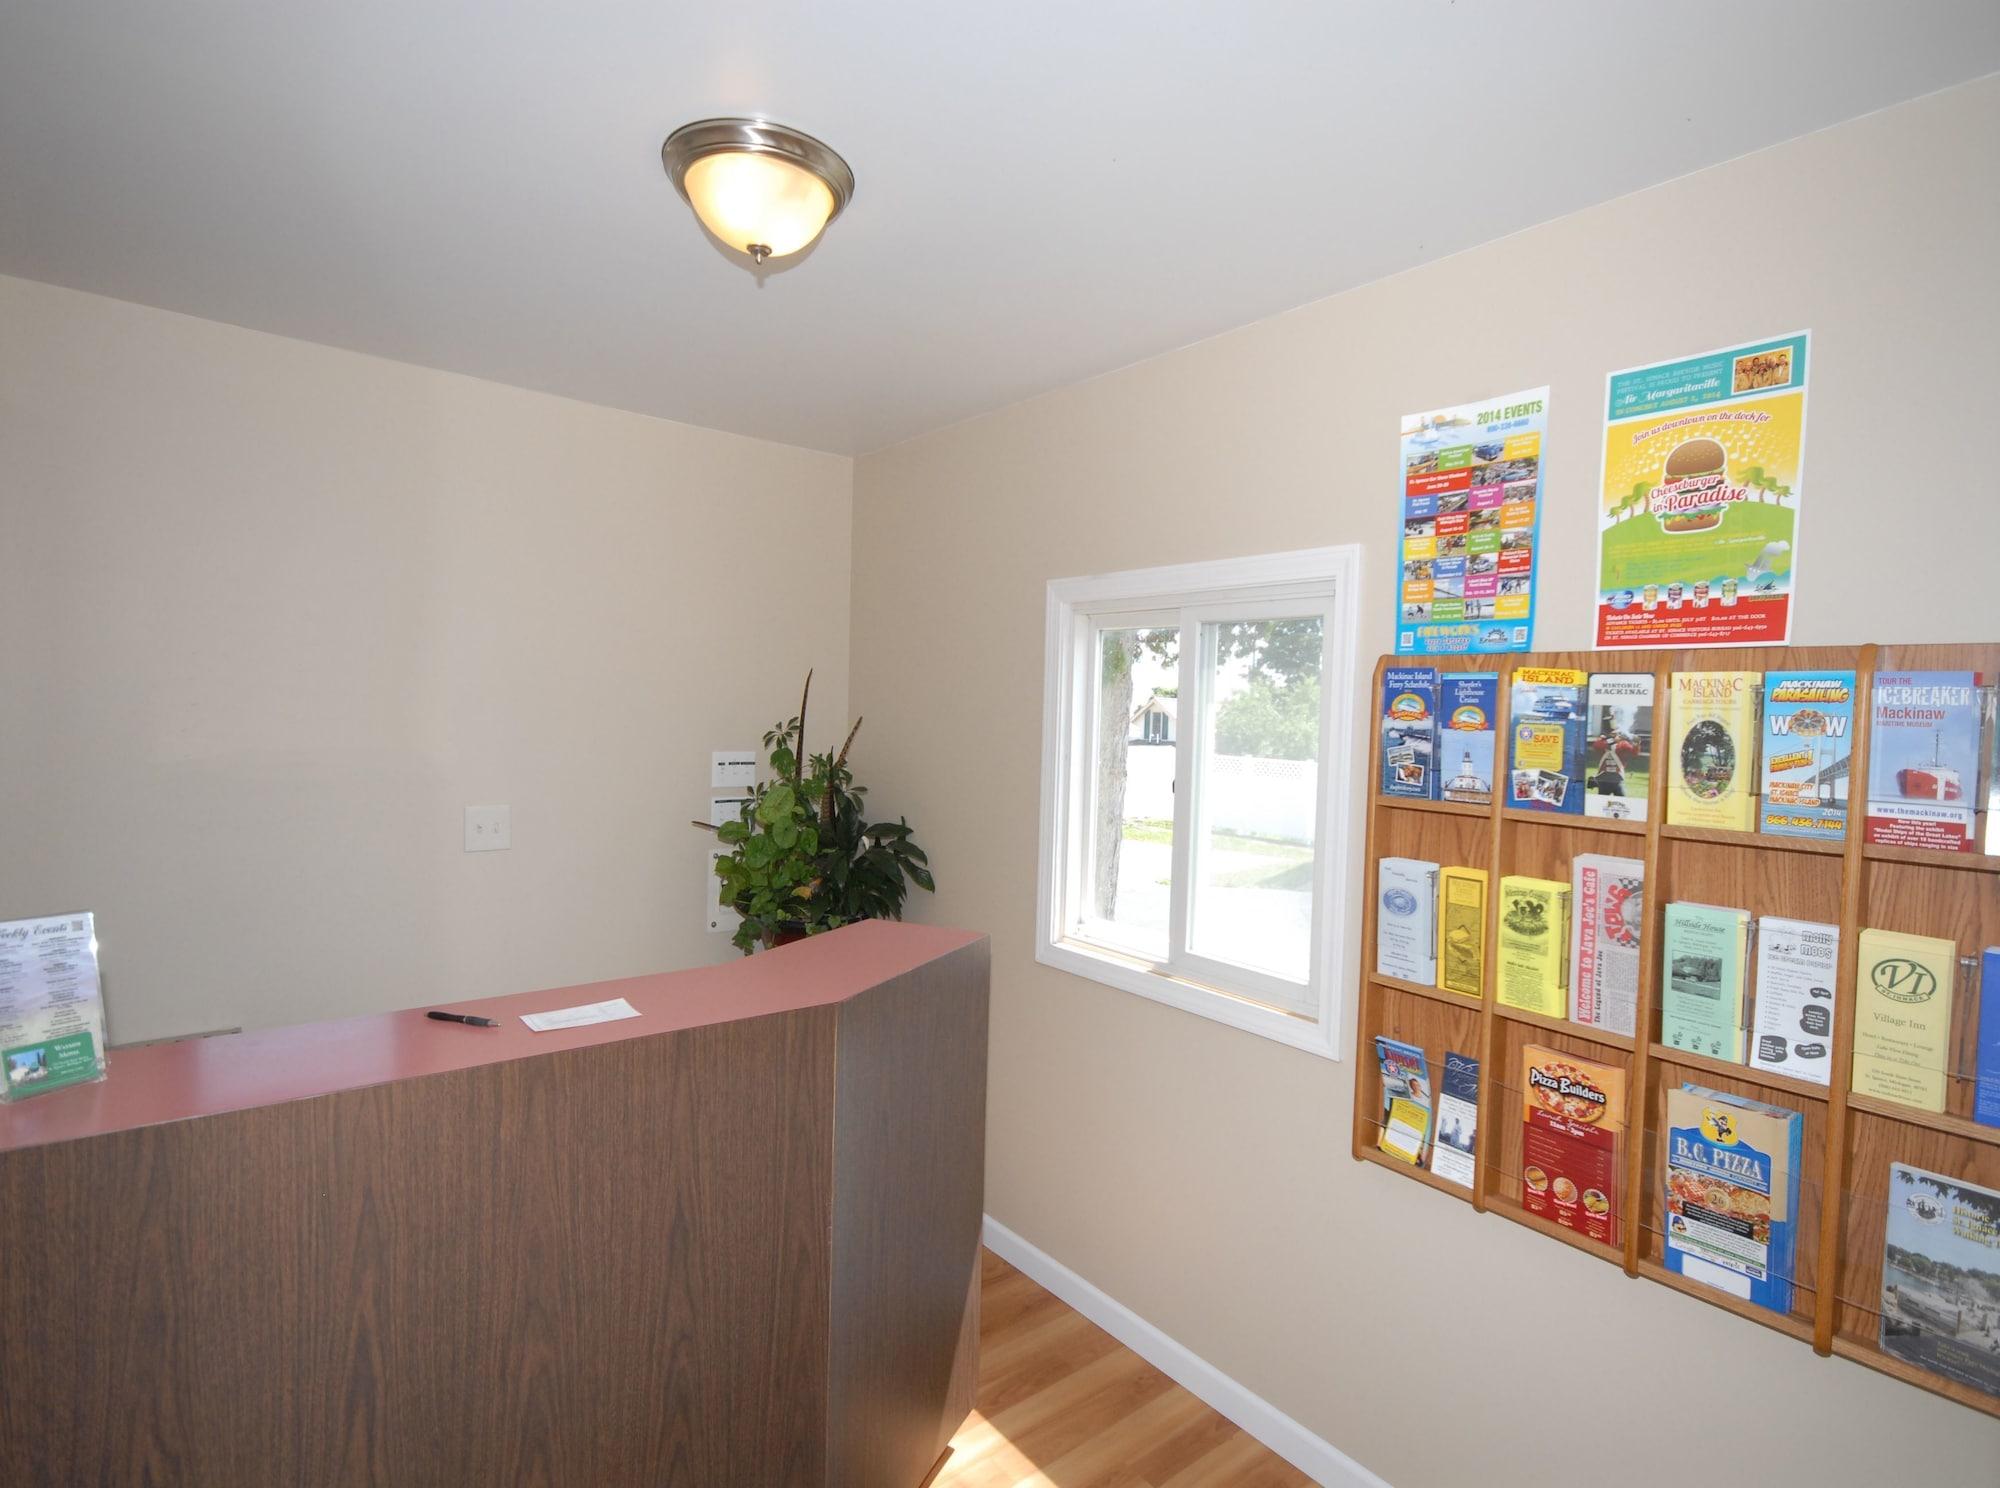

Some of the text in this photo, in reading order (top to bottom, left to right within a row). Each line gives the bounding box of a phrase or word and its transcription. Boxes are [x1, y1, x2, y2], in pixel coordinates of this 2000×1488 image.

[1477, 409, 1502, 426] 2014
[1505, 400, 1544, 420] EVENTS
[1633, 411, 1771, 444] Join us downtown on the dock for
[1650, 475, 1719, 500] Cheeseburger
[1653, 487, 1747, 513] in Paradise
[1387, 671, 1433, 680] Mackinac Island
[1522, 674, 1574, 684] ISLAND
[1879, 677, 1913, 686] TOUR THE
[1594, 688, 1649, 697] MACKINAC
[1601, 682, 1642, 690] HISTORIC
[1679, 678, 1744, 692] MACKINAC
[1692, 687, 1733, 699] ISLAND
[1780, 679, 1843, 690] MACKINAW
[1770, 688, 1850, 703] PARASAILING
[1877, 686, 1970, 707] ICEBREAKER
[1876, 706, 1946, 721] Mackinaw
[1533, 734, 1560, 744] SAVE
[1876, 807, 1963, 820] www.themackinaw.org
[1582, 898, 1595, 927] Joe's
[0, 923, 68, 942] eekly Events
[1703, 922, 1726, 934] House
[1581, 928, 1594, 955] Java
[1580, 957, 1592, 970] to
[1880, 962, 1929, 996] VI
[1578, 972, 1592, 1022] Welcome
[1594, 988, 1602, 1010] Legend
[1873, 1011, 1926, 1031] Village Inn
[1530, 1067, 1606, 1104] Pizza Builders
[1676, 1137, 1765, 1181] B.C. PIZZA
